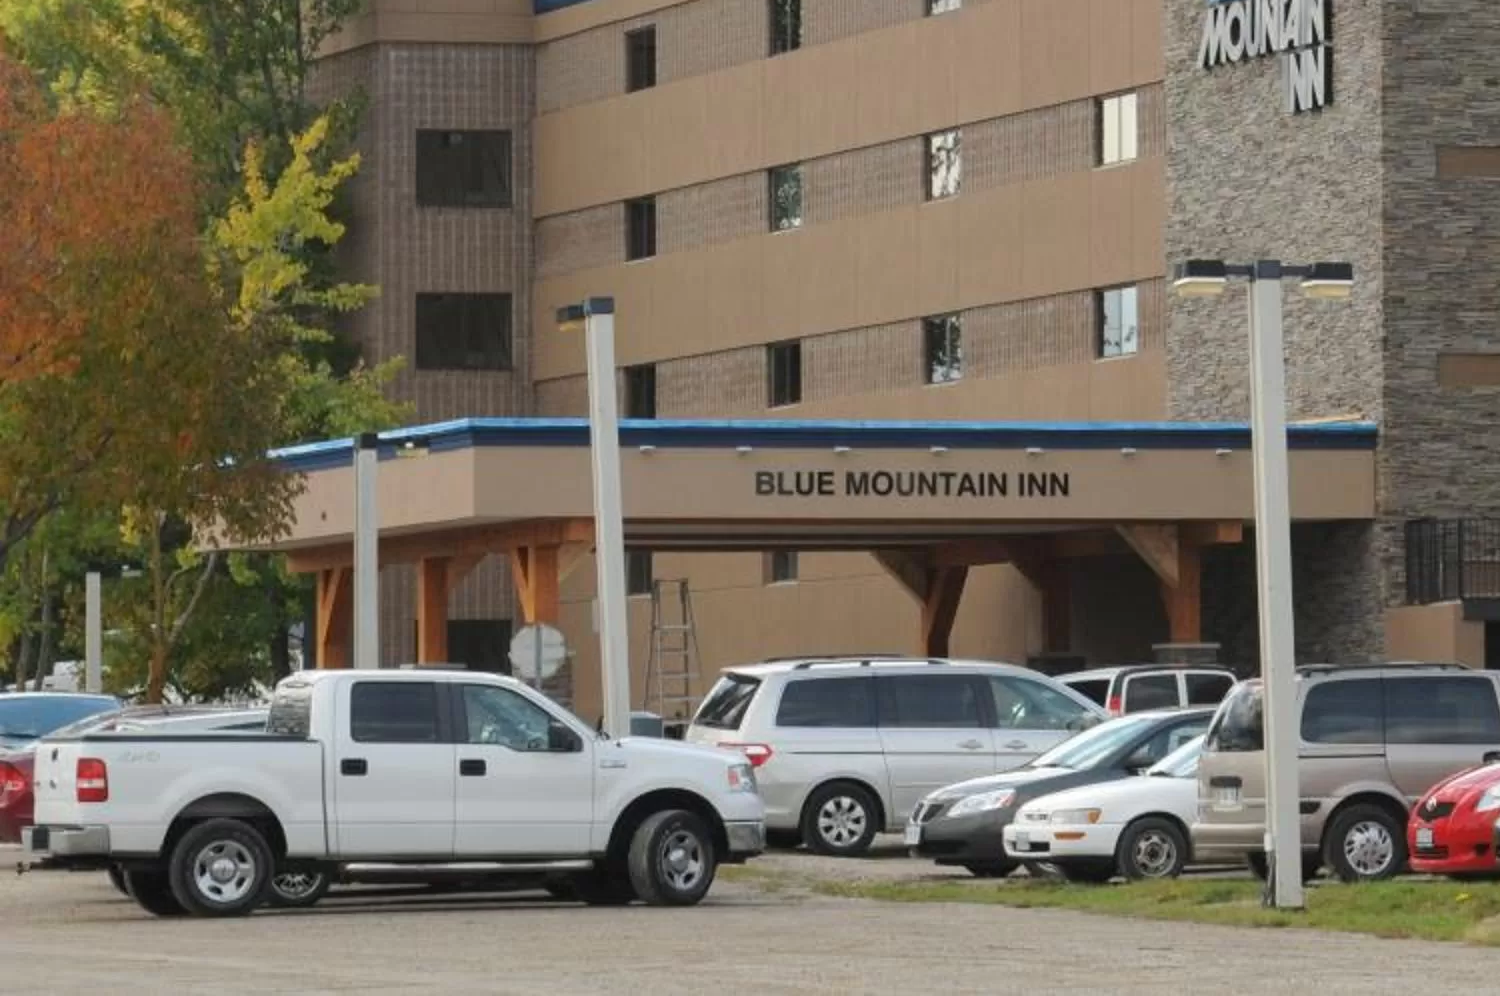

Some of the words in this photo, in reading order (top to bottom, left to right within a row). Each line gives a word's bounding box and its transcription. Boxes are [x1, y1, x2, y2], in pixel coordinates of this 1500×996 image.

[1282, 44, 1327, 115] INN
[755, 471, 835, 496] BLUE
[845, 471, 1008, 497] MOUNTAIN
[1018, 472, 1069, 497] INN
